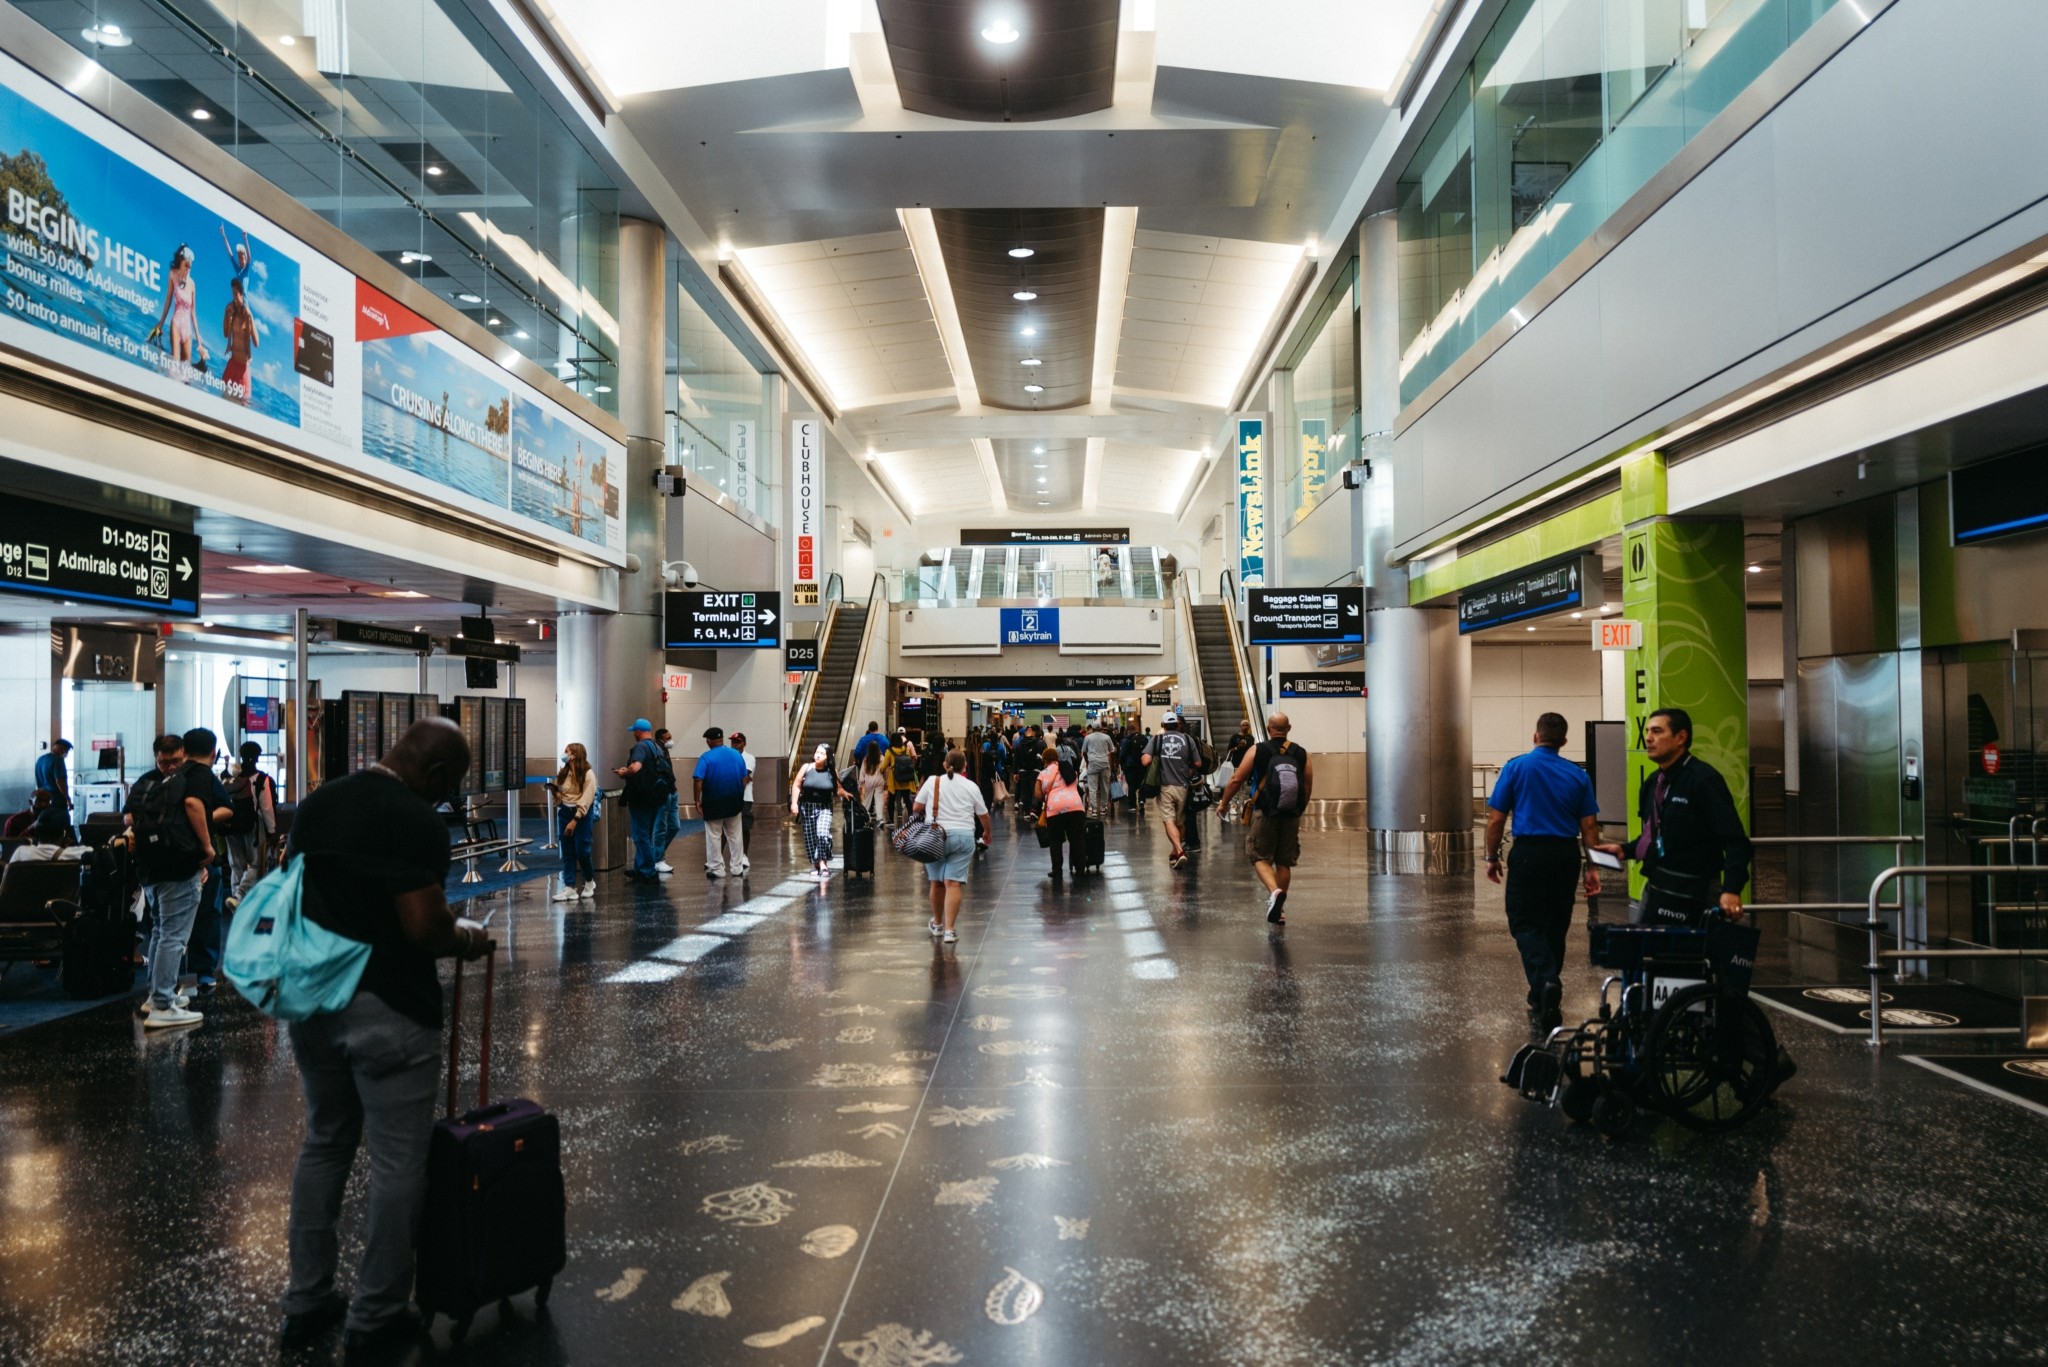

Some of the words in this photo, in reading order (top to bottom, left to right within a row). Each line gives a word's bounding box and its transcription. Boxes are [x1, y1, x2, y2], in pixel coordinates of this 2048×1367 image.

[8, 187, 98, 262] BEGINS
[105, 236, 161, 292] HERE
[6, 233, 38, 261] with
[40, 246, 84, 280] 50,000
[6, 253, 48, 288] bonus
[50, 277, 86, 304] miles.
[6, 287, 25, 311] $0
[27, 295, 59, 325] intro
[60, 314, 101, 343] annual
[102, 327, 122, 350] fee
[123, 337, 140, 357] for
[141, 344, 159, 365] the
[160, 352, 182, 373] first
[182, 363, 205, 384] year,
[205, 371, 226, 392] then
[391, 383, 442, 427] CRUISING
[442, 409, 476, 441] ALONG
[476, 427, 503, 455] THERE
[517, 446, 544, 476] BEGINS
[544, 461, 562, 484] HERE
[801, 423, 811, 535] CLUBHOUSE
[1240, 434, 1264, 559] NewsLink
[102, 525, 149, 552] D1-D25
[0, 542, 23, 563] ge
[58, 548, 118, 576] Admirals
[119, 559, 149, 581] Club
[801, 538, 811, 578] one
[6, 564, 22, 577] D12
[794, 583, 818, 593] KITCHEN
[1527, 575, 1545, 592] Terminal
[1547, 571, 1558, 586] EXIT
[703, 593, 740, 608] EXIT
[794, 595, 799, 604] &
[805, 595, 818, 604] BAR
[1263, 594, 1298, 604] Baggage
[1299, 594, 1322, 603] Claim
[1300, 603, 1322, 611] Equipaje
[692, 612, 740, 622] Terminal
[1025, 616, 1035, 629] 2
[1253, 614, 1283, 623] Ground
[1284, 613, 1322, 623] Transport
[359, 628, 378, 640] FLIGHT
[379, 631, 413, 645] INFORMATION
[693, 628, 703, 640] F,
[705, 628, 718, 640] G,
[719, 628, 731, 640] H,
[732, 628, 740, 638] J
[1019, 631, 1052, 642] skytrain
[1602, 624, 1631, 646] EXIT
[789, 648, 814, 659] D25
[670, 675, 688, 688] EXIT
[788, 674, 801, 684] EXIT
[1103, 678, 1124, 686] skytrain
[1318, 685, 1343, 693] Baggage
[1657, 907, 1689, 921] envoy
